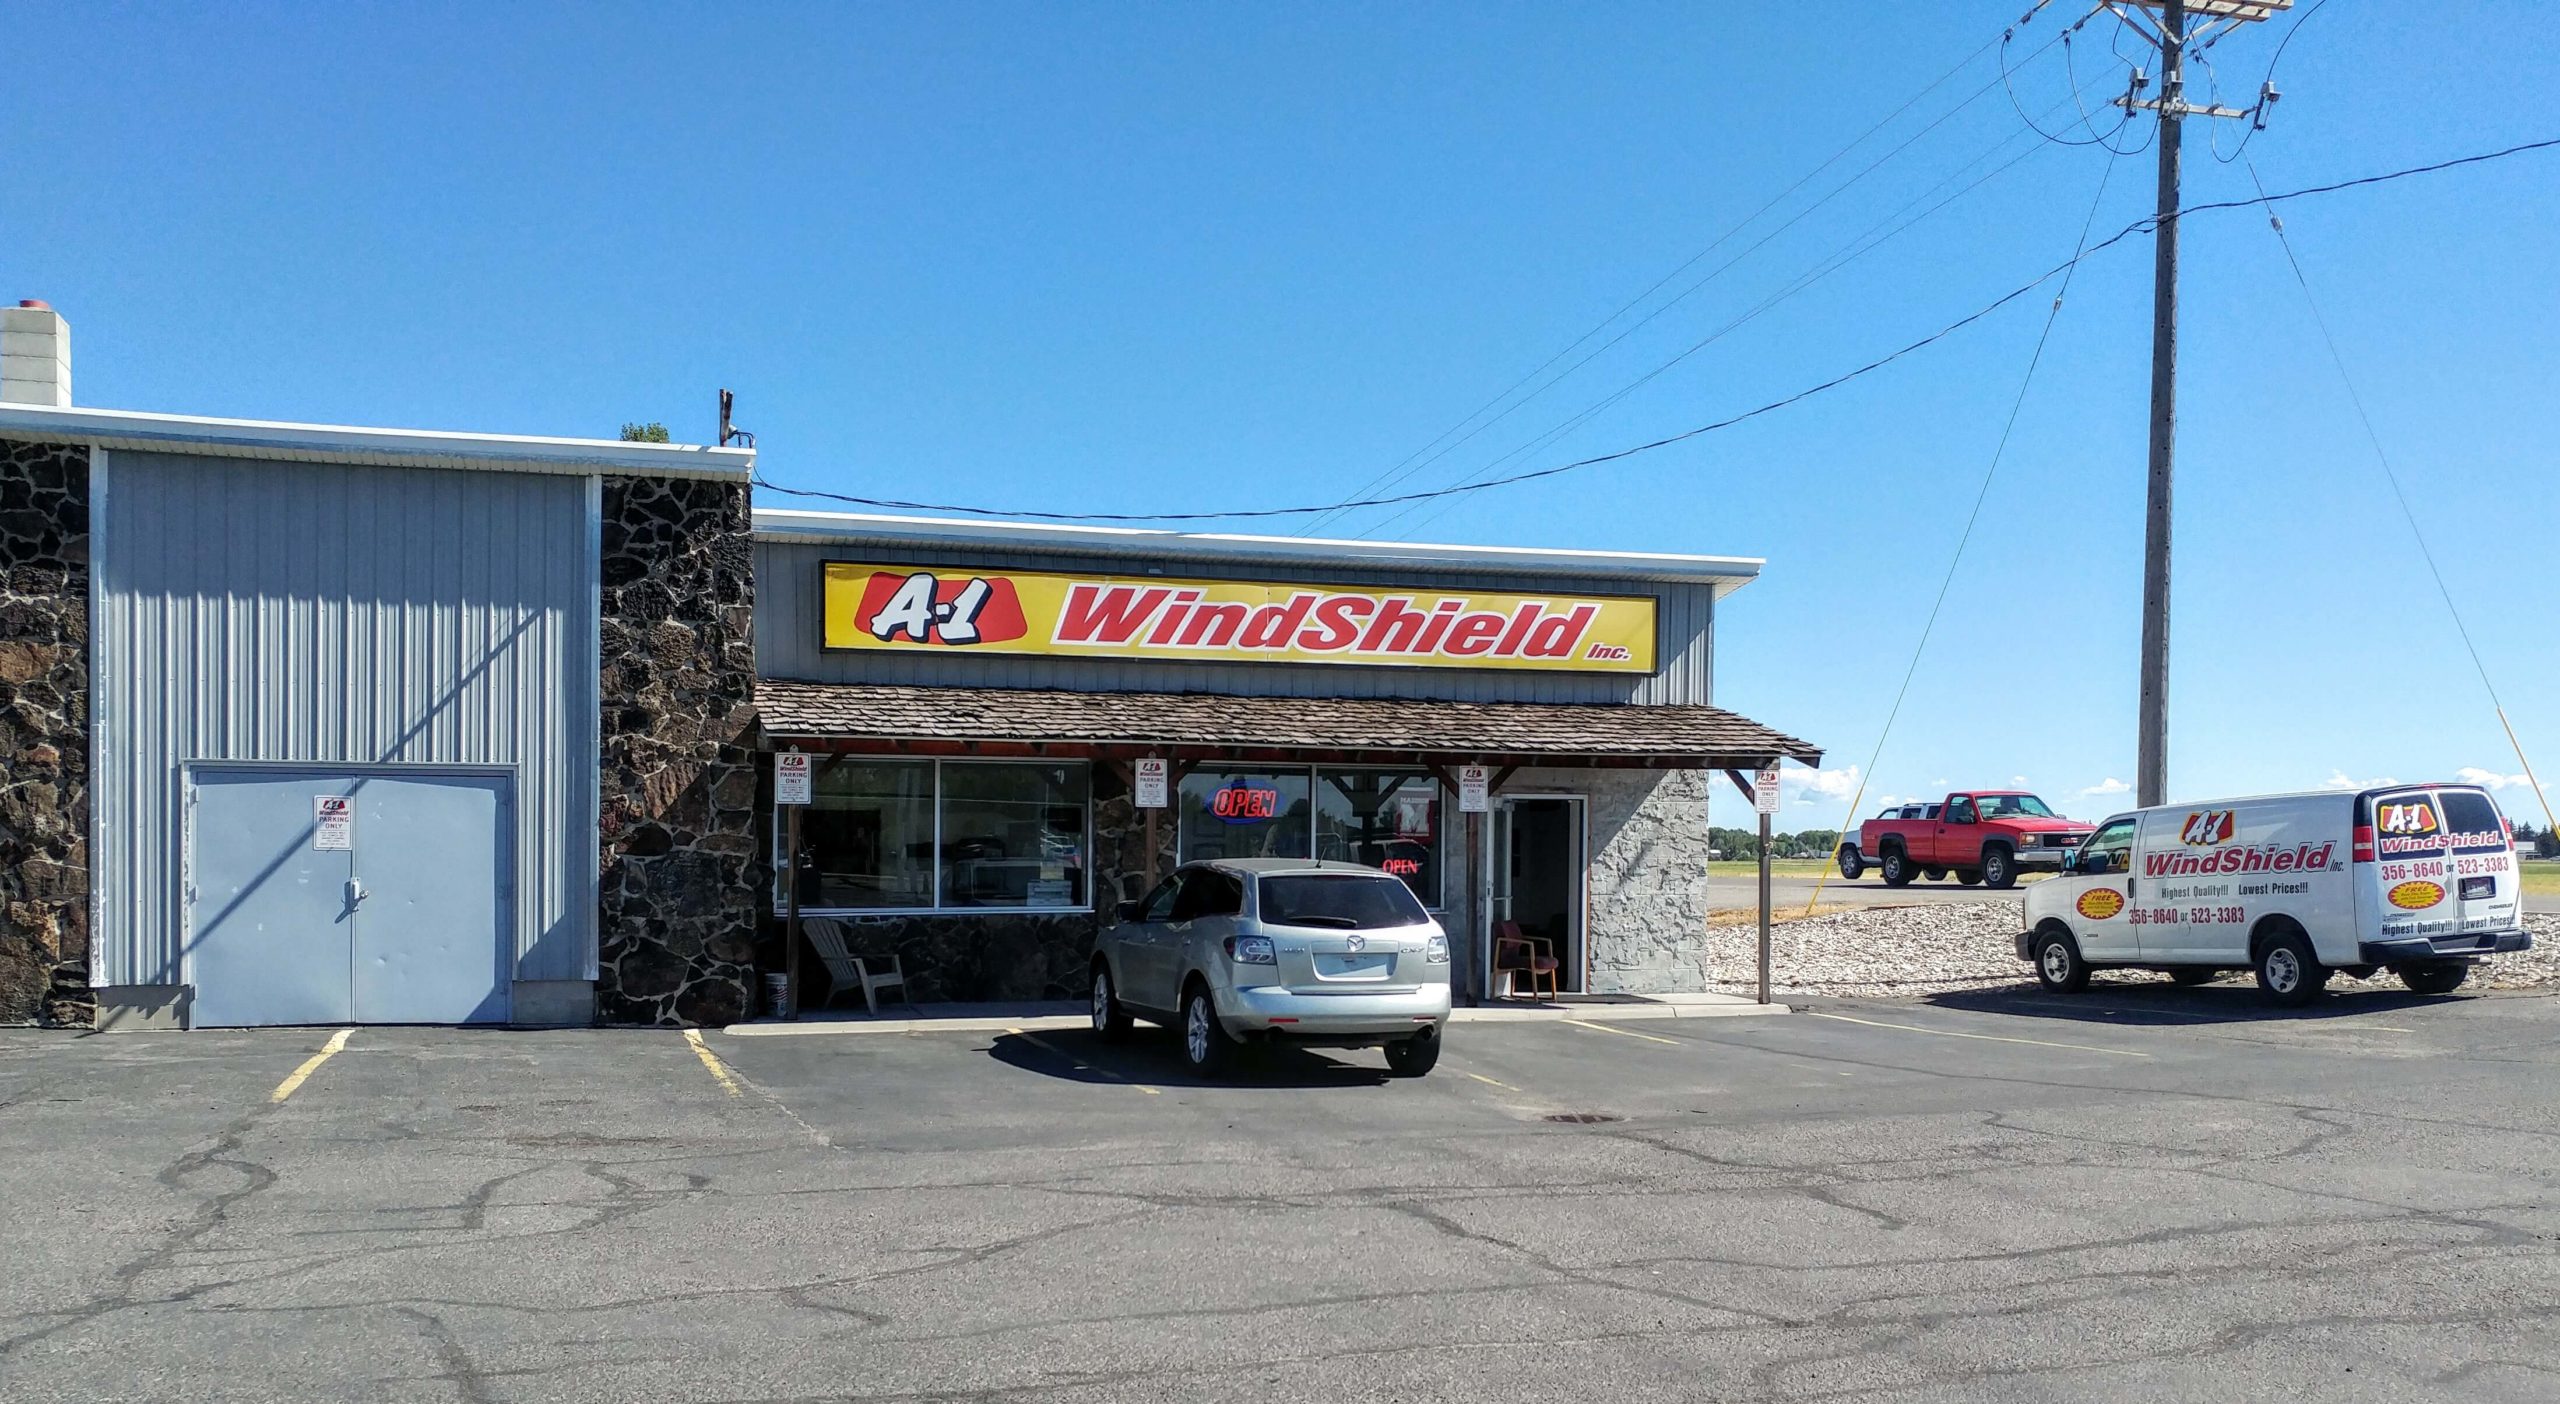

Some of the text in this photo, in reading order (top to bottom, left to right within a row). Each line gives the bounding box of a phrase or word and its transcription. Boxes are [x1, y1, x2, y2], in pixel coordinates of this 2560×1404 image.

[870, 572, 993, 645] A-1
[1054, 584, 1630, 659] WindShield Inc.
[1214, 788, 1276, 817] OPEN
[2387, 804, 2423, 833] A-1
[2380, 831, 2498, 854] WindShield
[1382, 859, 1417, 874] OPEN
[2145, 842, 2344, 878] WindShield Inc.
[2381, 856, 2509, 881] 356-8640 or 523-3383
[2162, 882, 2308, 900] Highest Quality!!! Lowest Prices!!!
[2129, 907, 2245, 925] 356-8640 or 523-3383
[2382, 923, 2413, 937] Highest
[2418, 920, 2453, 934] Quality!!!
[2462, 918, 2487, 929] Lowest
